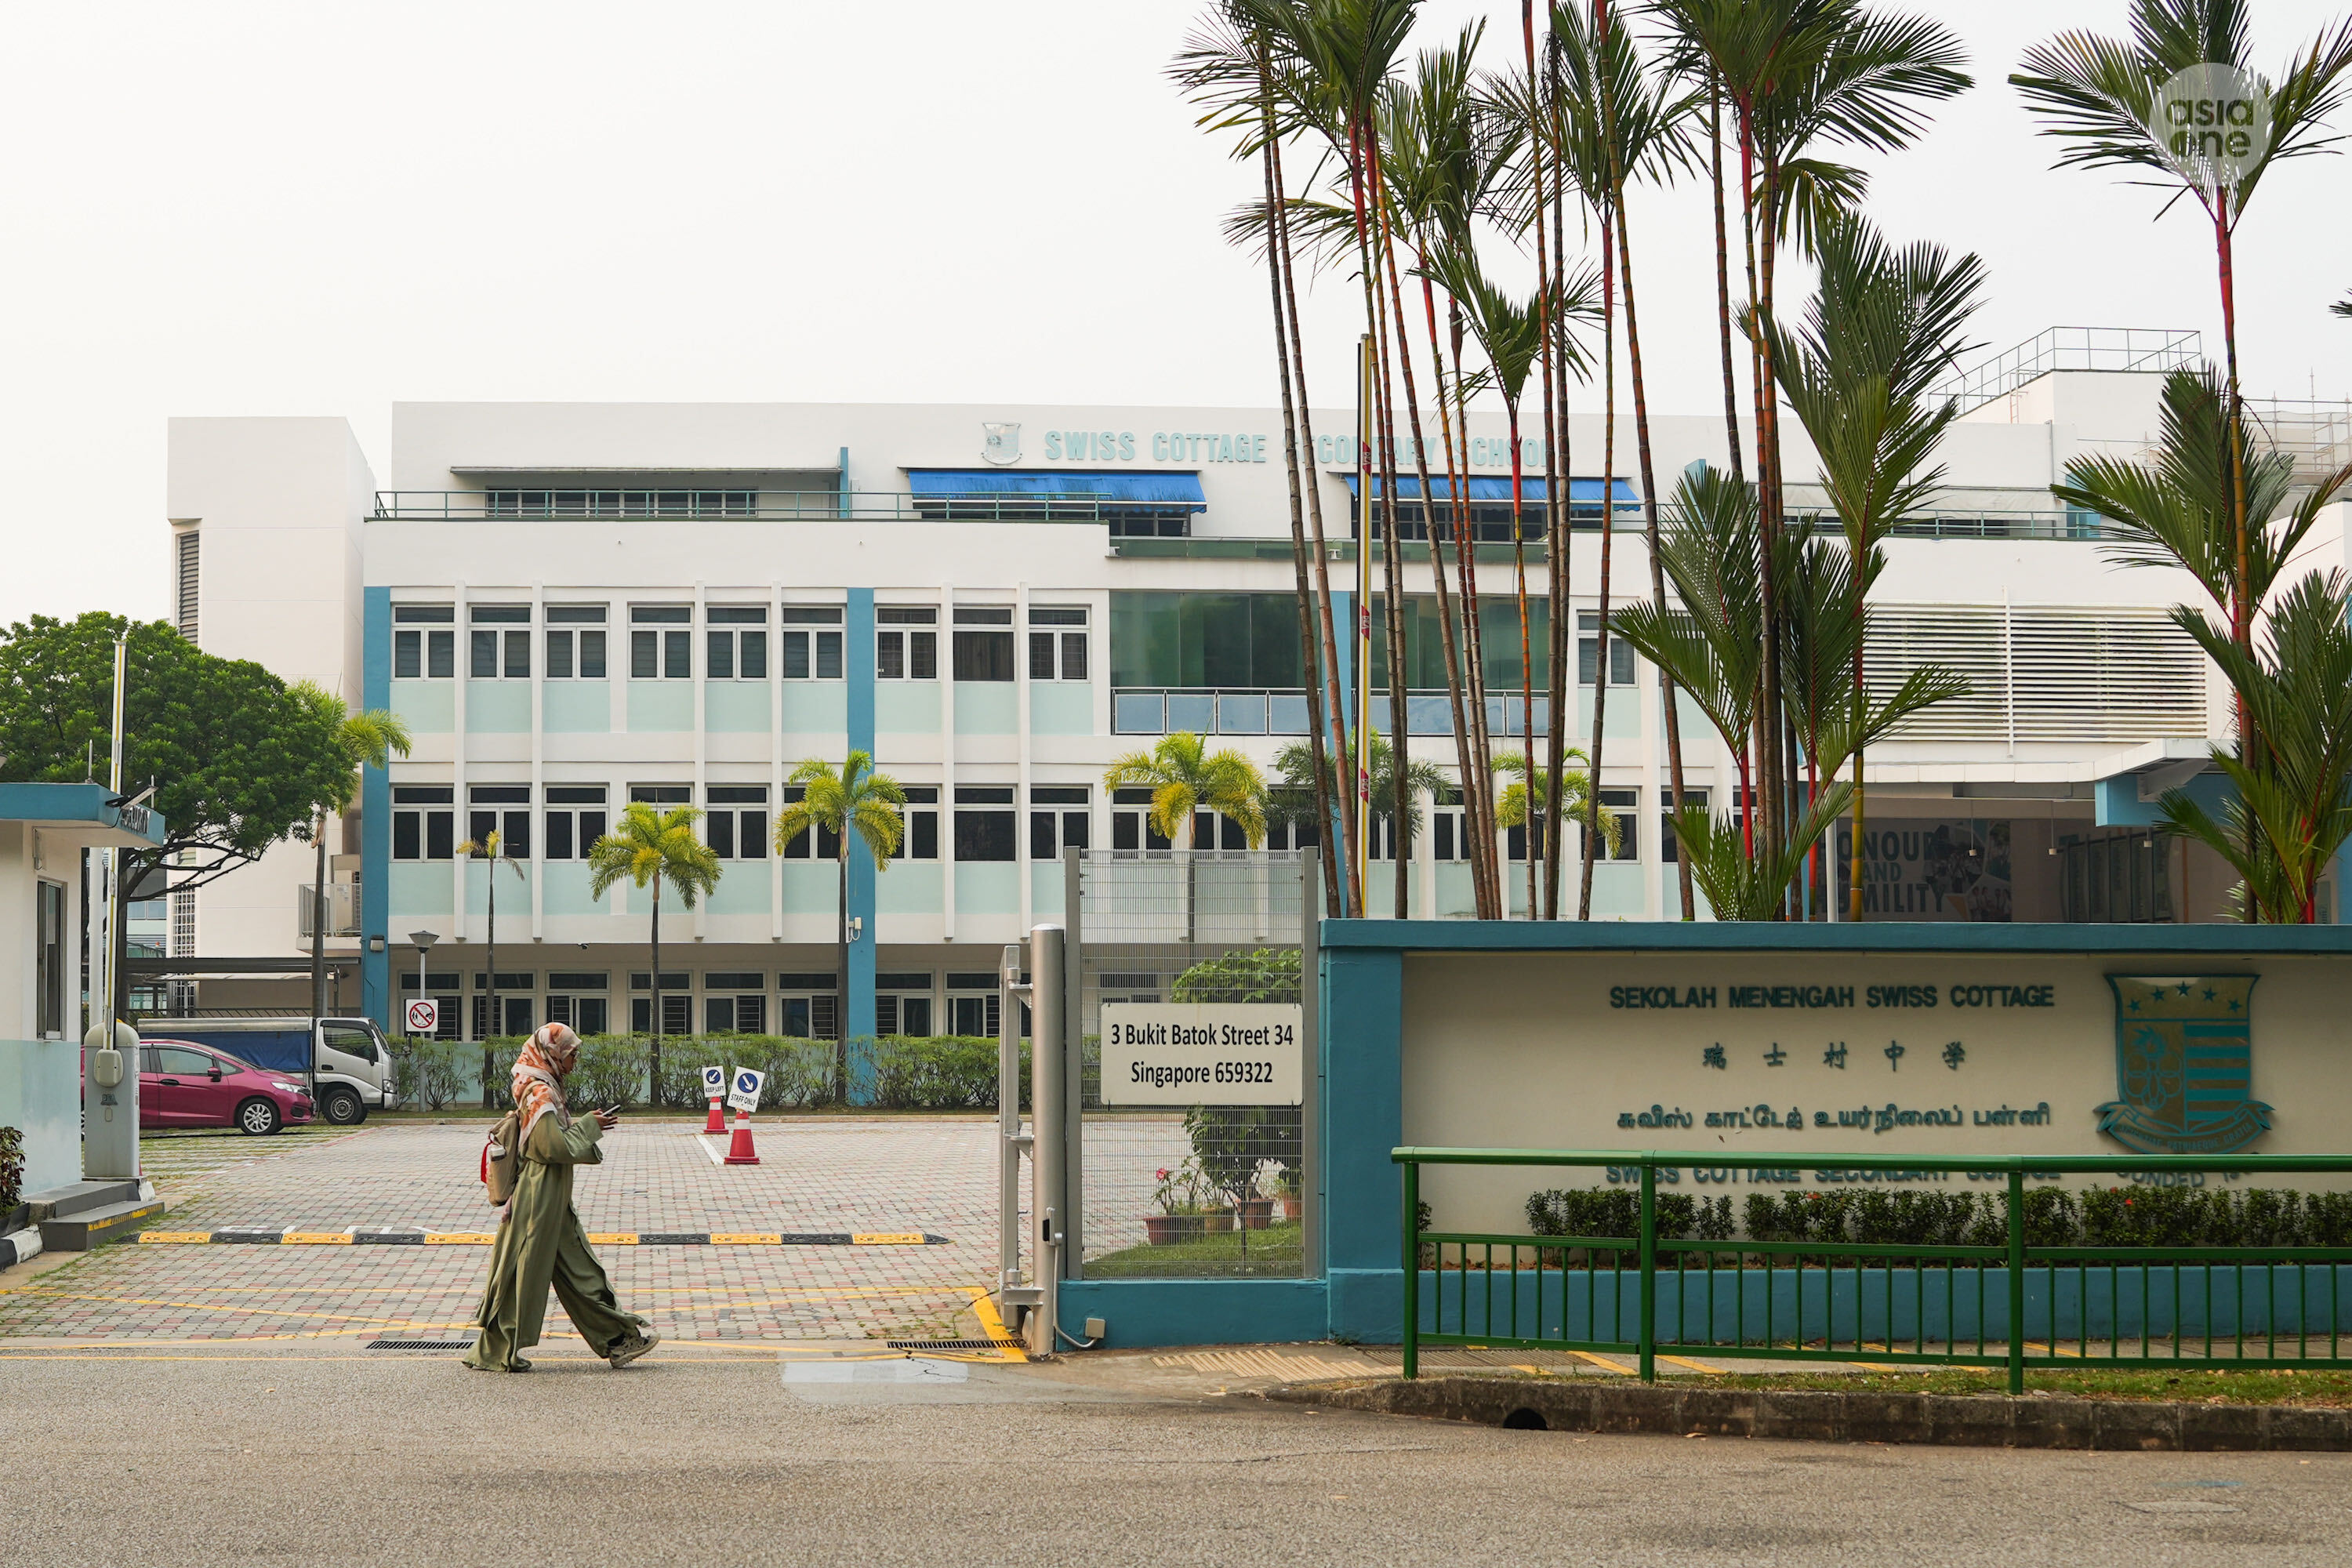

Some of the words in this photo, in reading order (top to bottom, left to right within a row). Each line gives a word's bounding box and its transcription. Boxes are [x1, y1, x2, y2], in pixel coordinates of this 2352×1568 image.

[1044, 430, 1136, 461] SWISS
[1152, 432, 1267, 463] COTTAGE
[1283, 434, 1437, 465] COARY
[1610, 986, 1717, 1008] SEKOLAH
[1729, 986, 1855, 1008] MENENGAH
[1866, 985, 1938, 1008] SWISS
[1950, 985, 2055, 1007] COTTAGE
[1111, 1024, 1120, 1045] 3
[1126, 1023, 1167, 1045] Bukit
[1172, 1023, 1217, 1045] Batok
[1221, 1024, 1270, 1045] Street
[1274, 1024, 1294, 1045] 34
[1131, 1061, 1210, 1088] Singapore
[1215, 1062, 1273, 1083] 659322
[731, 1094, 744, 1102] STAFF
[744, 1097, 757, 1106] ONLY
[1606, 1165, 1680, 1183] SWSS
